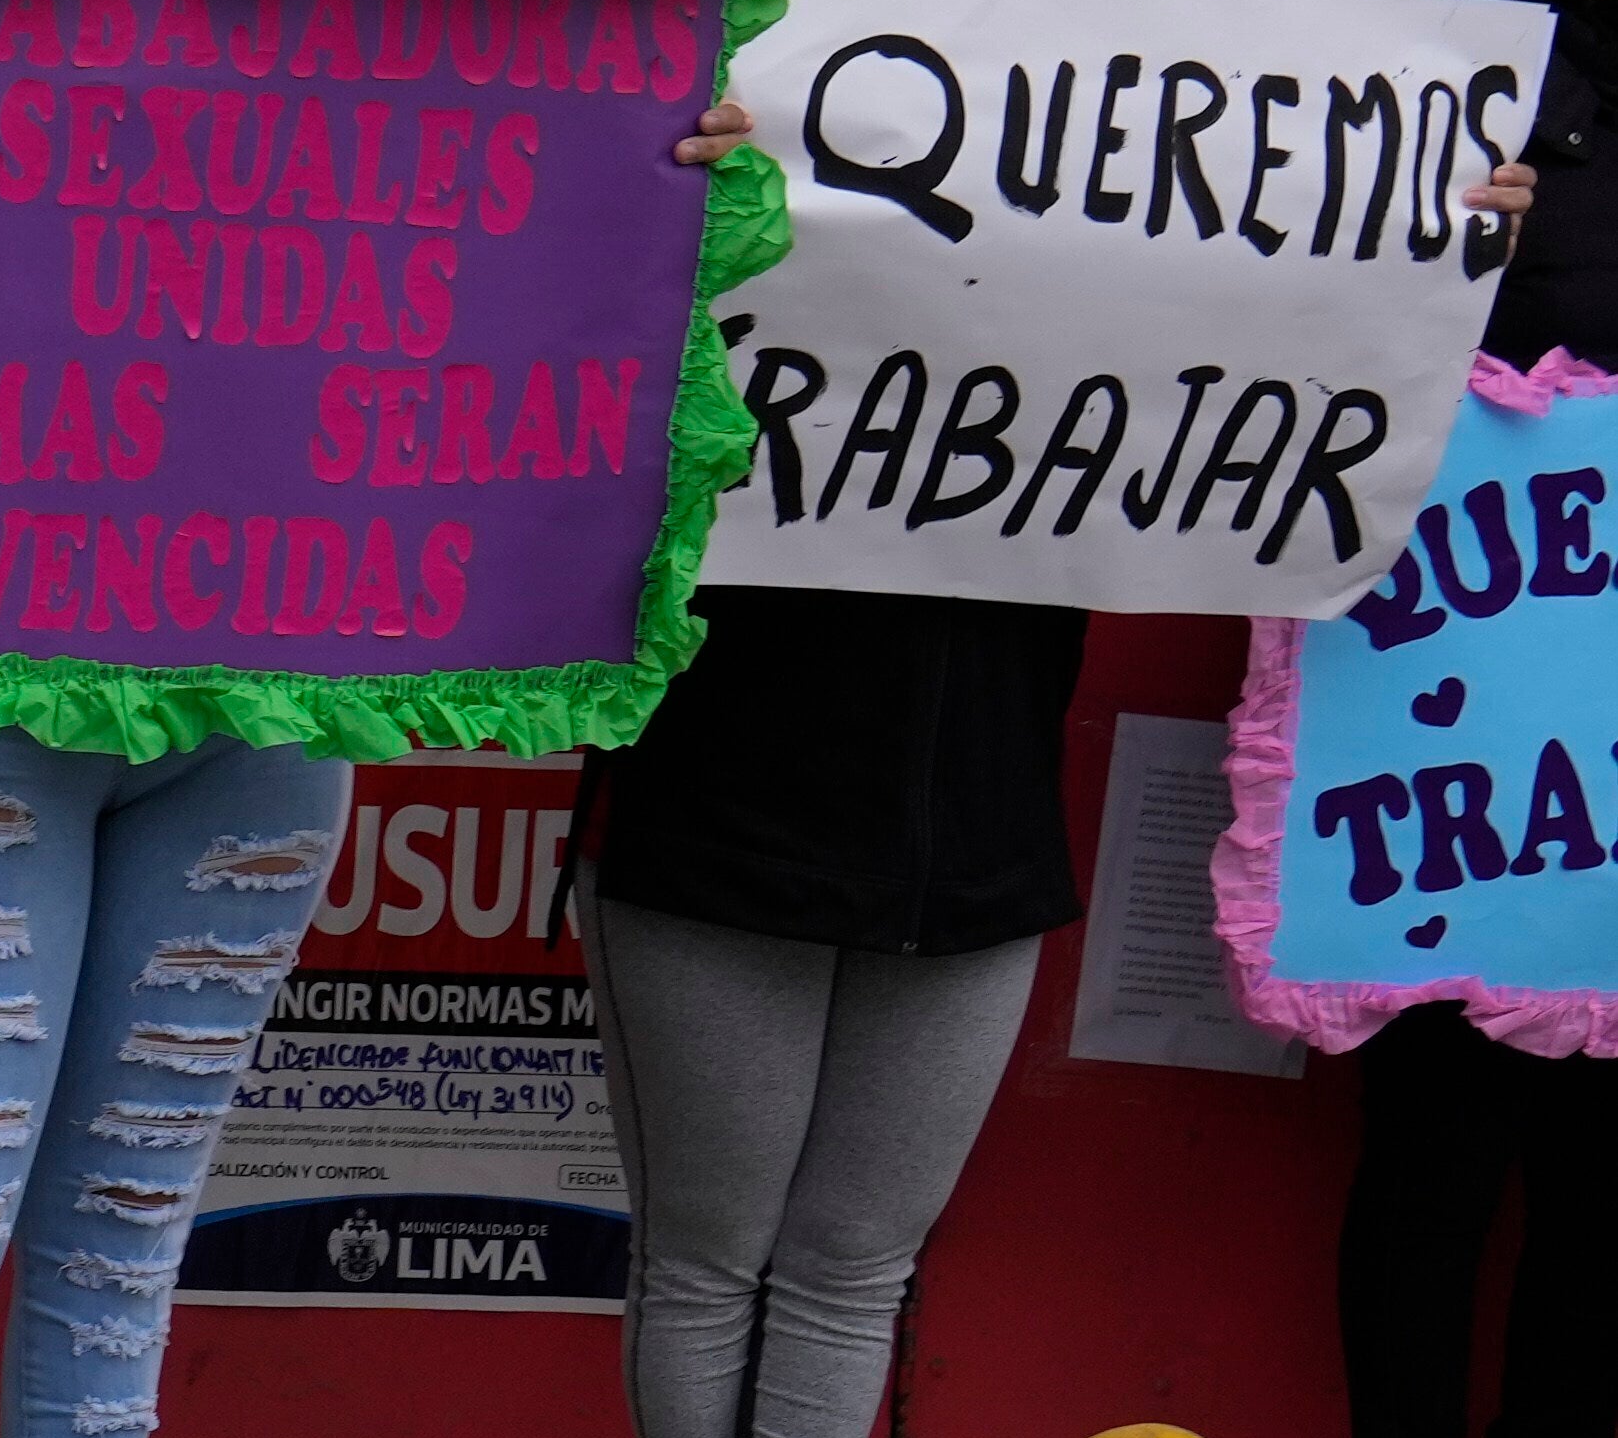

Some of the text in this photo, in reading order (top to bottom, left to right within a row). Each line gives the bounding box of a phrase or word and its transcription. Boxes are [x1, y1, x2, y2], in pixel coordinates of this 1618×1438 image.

[803, 33, 1519, 282] QUEREMOS
[70, 217, 459, 361] UNIDAS
[309, 357, 641, 486] SERAN
[1315, 737, 1618, 907] TRA
[380, 984, 553, 1025] NORMAS
[302, 1165, 390, 1180] Y CONTROL
[569, 1172, 620, 1186] FECHA
[399, 1221, 549, 1236] MUNICIPALIDAD DE
[396, 1237, 547, 1282] LIMA
